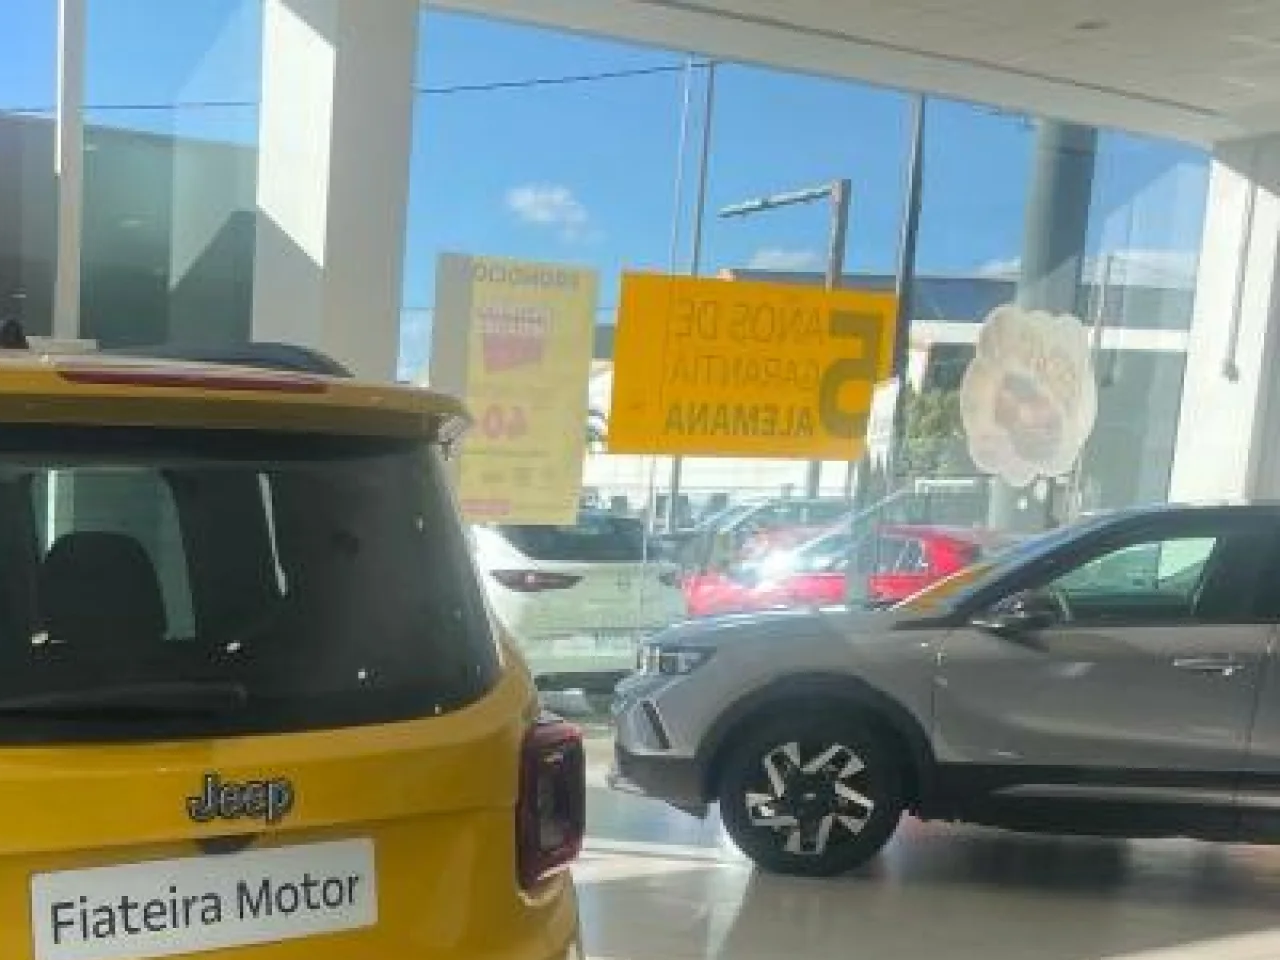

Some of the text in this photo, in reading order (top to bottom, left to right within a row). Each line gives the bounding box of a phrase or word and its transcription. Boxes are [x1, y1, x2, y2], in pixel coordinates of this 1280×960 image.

[185, 771, 294, 822] Jeep
[51, 873, 360, 945] Fiateira Motor
